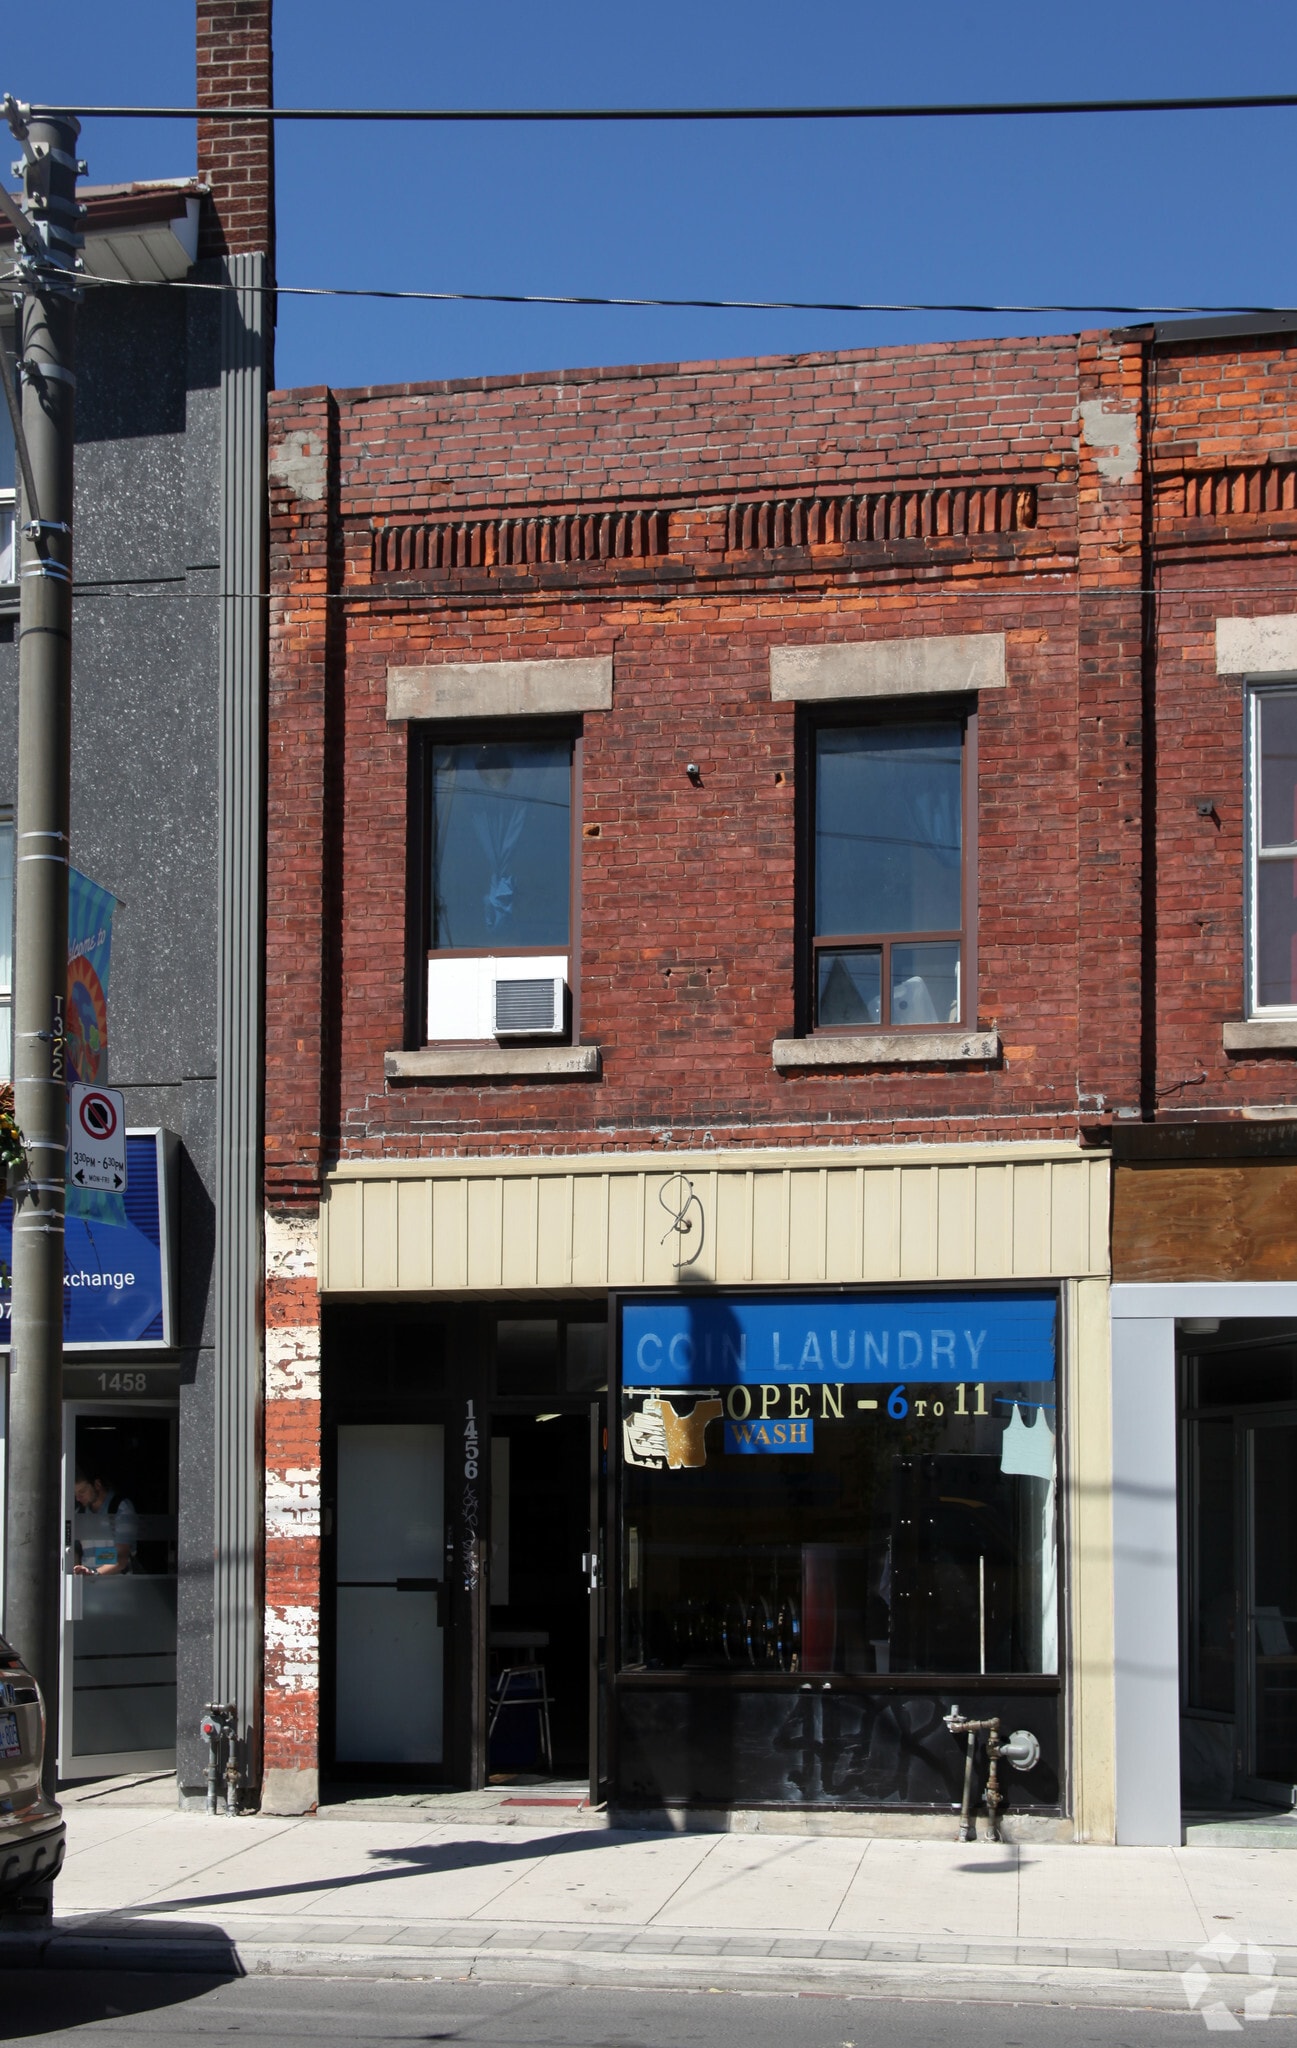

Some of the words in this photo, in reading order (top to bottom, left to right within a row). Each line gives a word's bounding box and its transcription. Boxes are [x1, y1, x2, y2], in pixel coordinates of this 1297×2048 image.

[52, 995, 64, 1079] T322
[637, 1332, 747, 1374] COIN
[772, 1329, 988, 1371] LAUNDRY
[97, 1372, 146, 1391] 1458
[727, 1383, 845, 1421] OPEN
[887, 1385, 909, 1420] 6
[954, 1382, 989, 1415] 11
[463, 1399, 479, 1479] 1456
[731, 1423, 808, 1445] WASH
